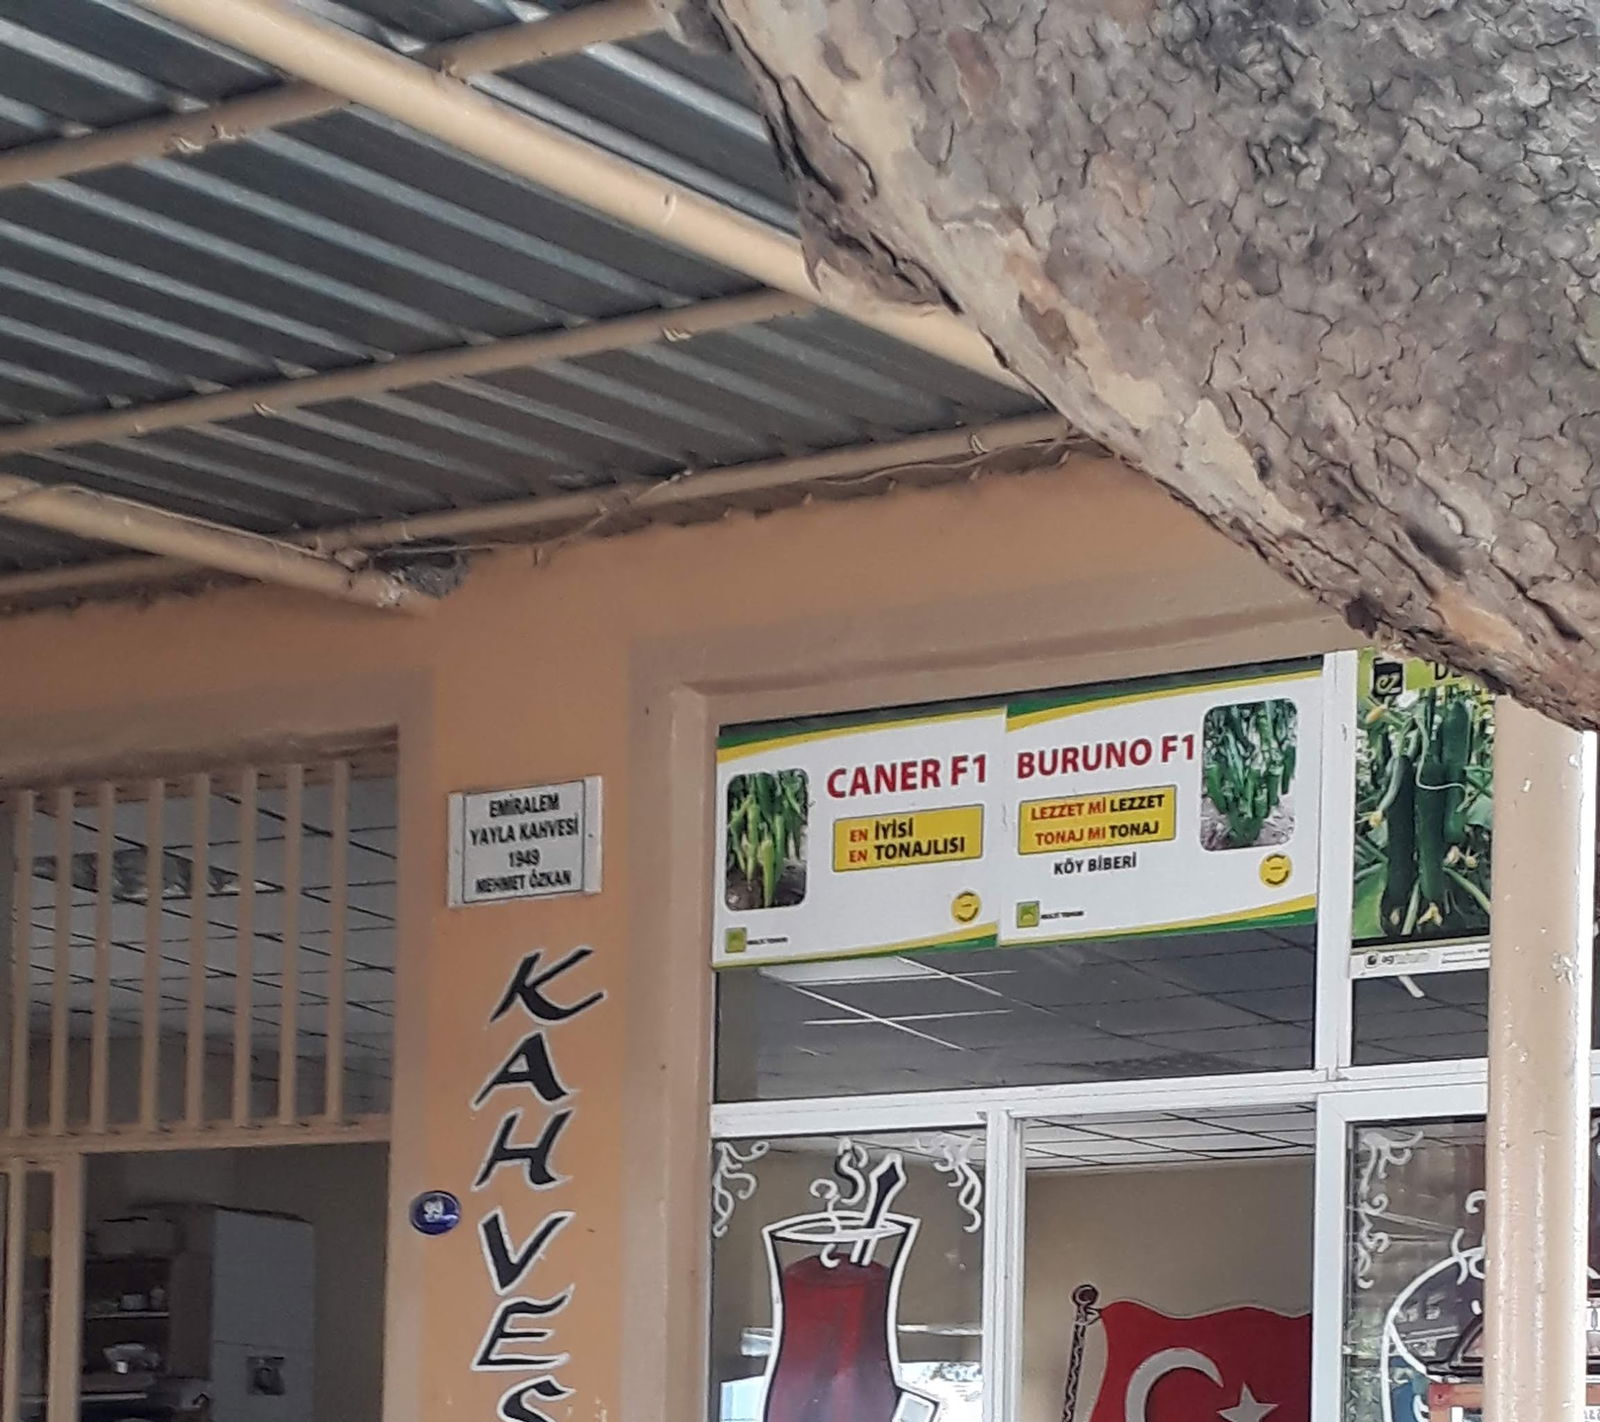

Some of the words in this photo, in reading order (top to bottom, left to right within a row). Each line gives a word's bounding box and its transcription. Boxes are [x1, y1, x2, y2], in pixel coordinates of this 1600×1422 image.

[1017, 738, 1152, 779] BURUNO
[1161, 734, 1194, 762] F1
[827, 758, 941, 798] CANER
[951, 754, 986, 785] F1
[1031, 803, 1084, 820] LEZZET
[1110, 794, 1165, 812] LEZZET
[470, 825, 516, 846] YAYLA
[519, 813, 579, 840] KAHVESİ
[849, 829, 868, 842] EN
[875, 818, 914, 840] İYİSİ
[1035, 830, 1084, 846] TONAJ
[1110, 821, 1160, 838] TONAJ
[848, 849, 868, 863] EN
[874, 837, 965, 860] TONAJLISI
[1053, 858, 1084, 875] KÖY
[1088, 851, 1137, 872] BİBERİ
